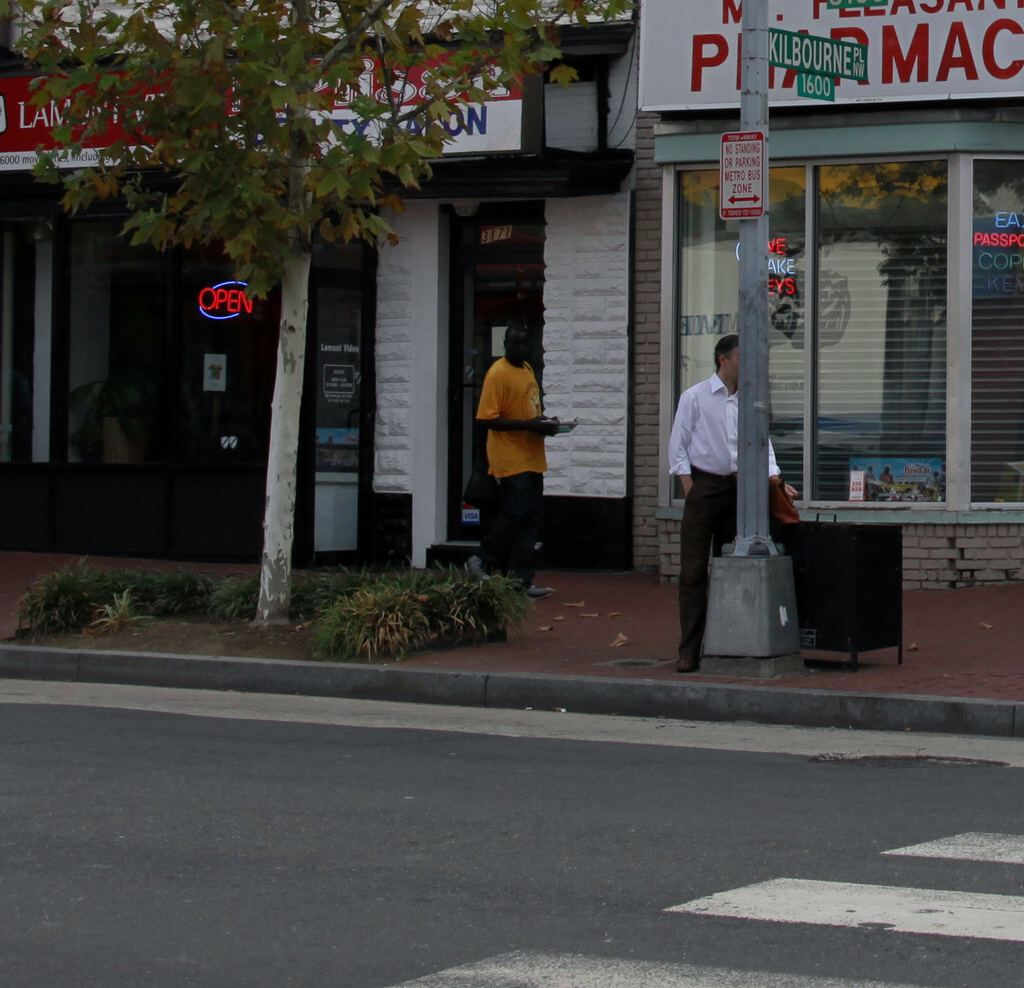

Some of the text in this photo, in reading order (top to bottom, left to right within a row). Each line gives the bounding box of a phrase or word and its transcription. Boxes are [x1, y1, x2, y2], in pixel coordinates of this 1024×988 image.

[769, 31, 864, 76] KILBOURNE PL
[853, 61, 865, 78] NW
[801, 73, 831, 97] 1600
[726, 143, 760, 155] NO STANDING
[725, 156, 760, 169] OR PARKING
[725, 170, 760, 182] METRO BUS
[733, 183, 753, 194] ZONE
[482, 226, 511, 243] 3171
[198, 286, 254, 314] OPEN
[321, 343, 359, 353] Lamont Video
[464, 512, 479, 520] VISA
